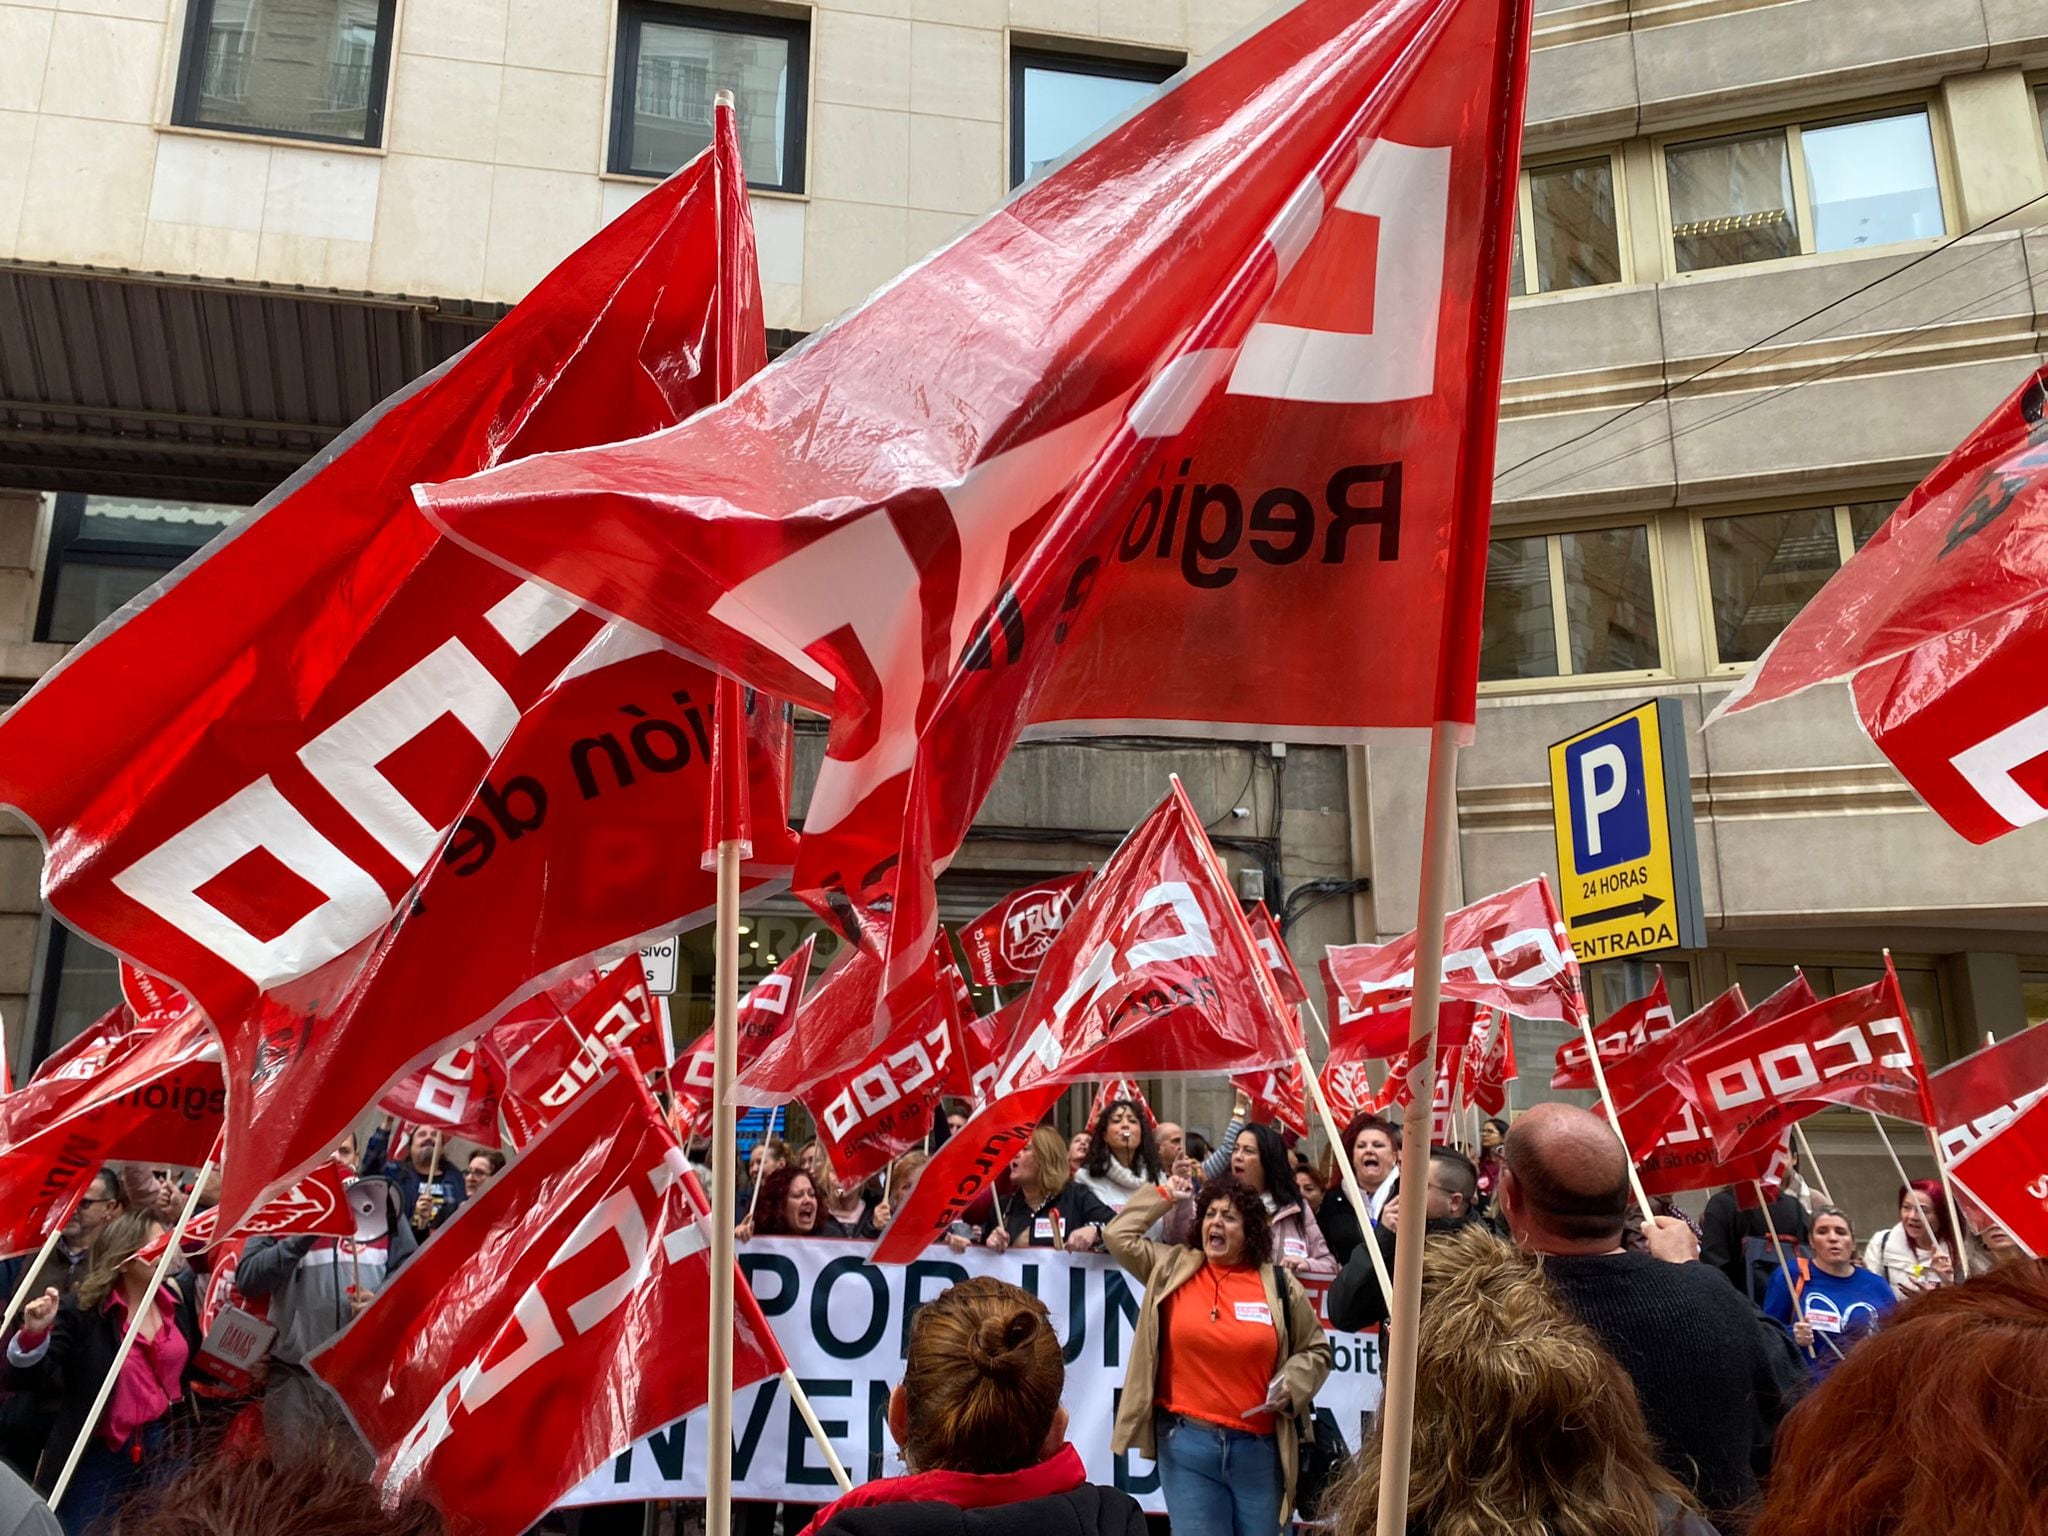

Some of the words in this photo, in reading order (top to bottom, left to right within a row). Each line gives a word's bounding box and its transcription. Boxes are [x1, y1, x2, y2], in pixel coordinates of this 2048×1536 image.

[1580, 743, 1628, 857] P
[1582, 880, 1597, 900] 24
[1600, 866, 1648, 895] HORAS
[1571, 923, 1673, 960] ENTRADA
[935, 1120, 1037, 1230] Murcia
